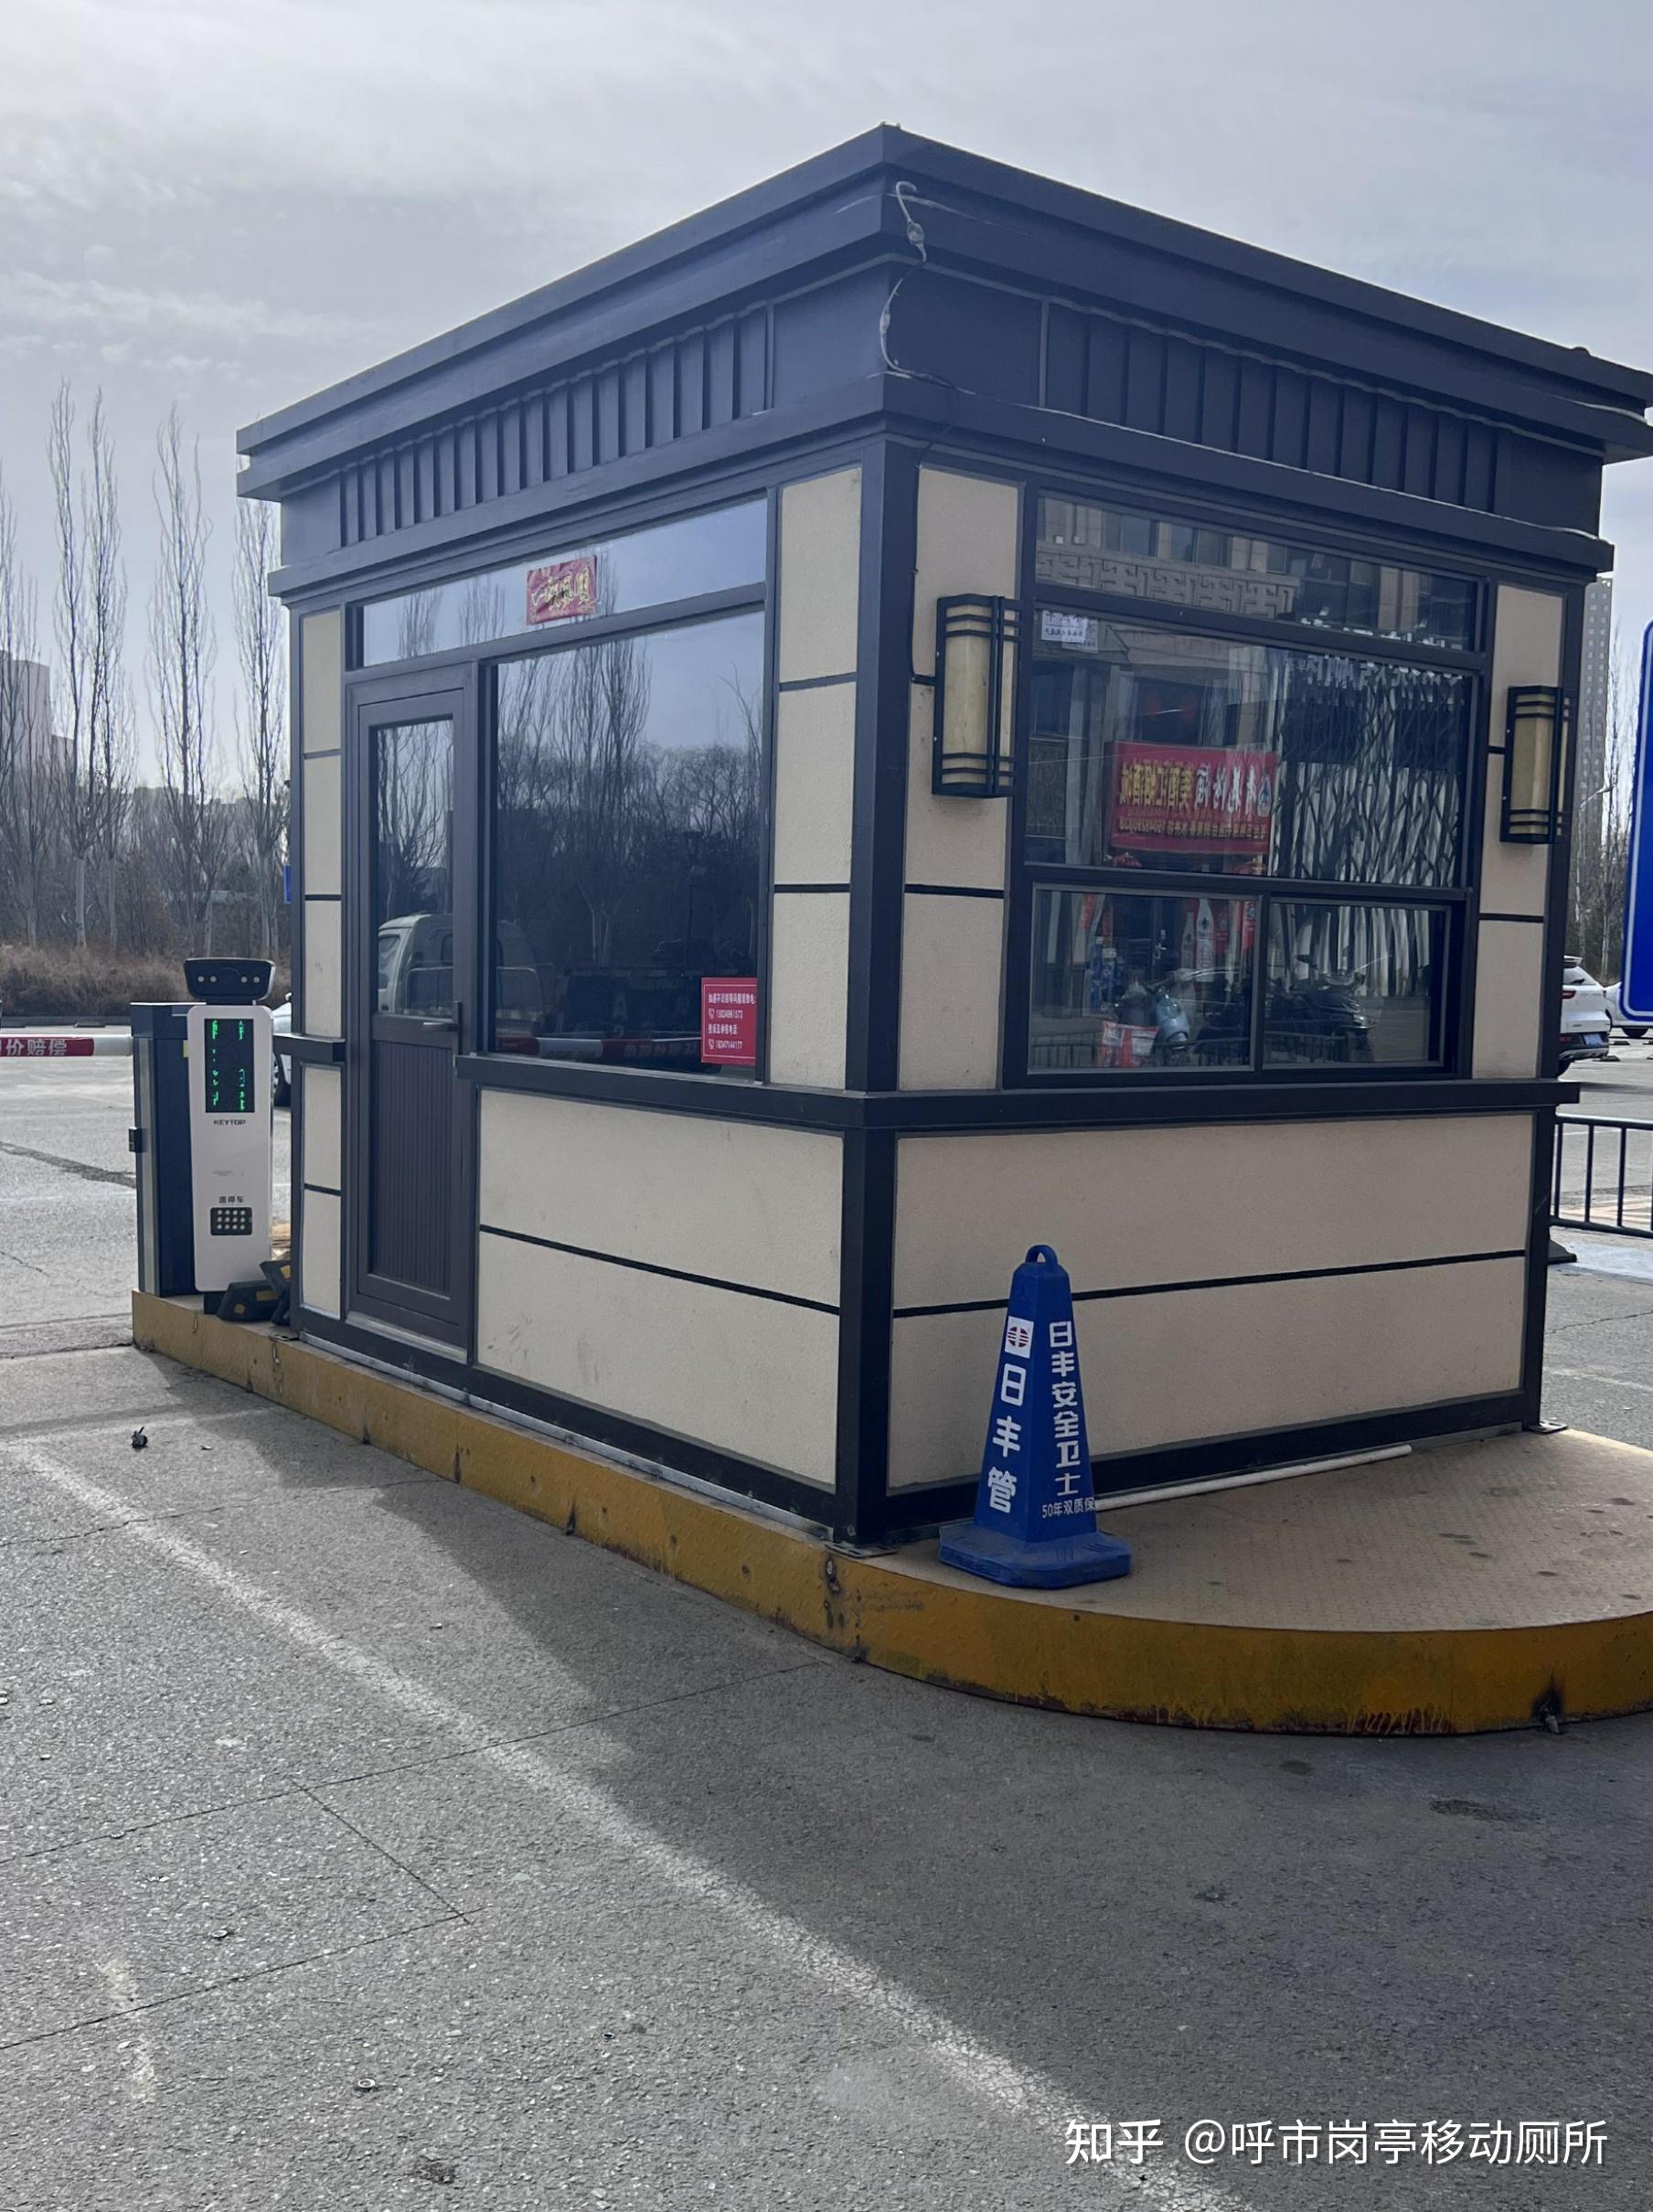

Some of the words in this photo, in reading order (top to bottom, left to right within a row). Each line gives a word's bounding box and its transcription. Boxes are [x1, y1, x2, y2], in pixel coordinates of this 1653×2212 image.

[0, 1039, 67, 1055] 价赔偿
[987, 1362, 1027, 1513] 日丰管
[1049, 1320, 1081, 1496] 日丰安全卫士
[1041, 1497, 1095, 1518] 50年双质保
